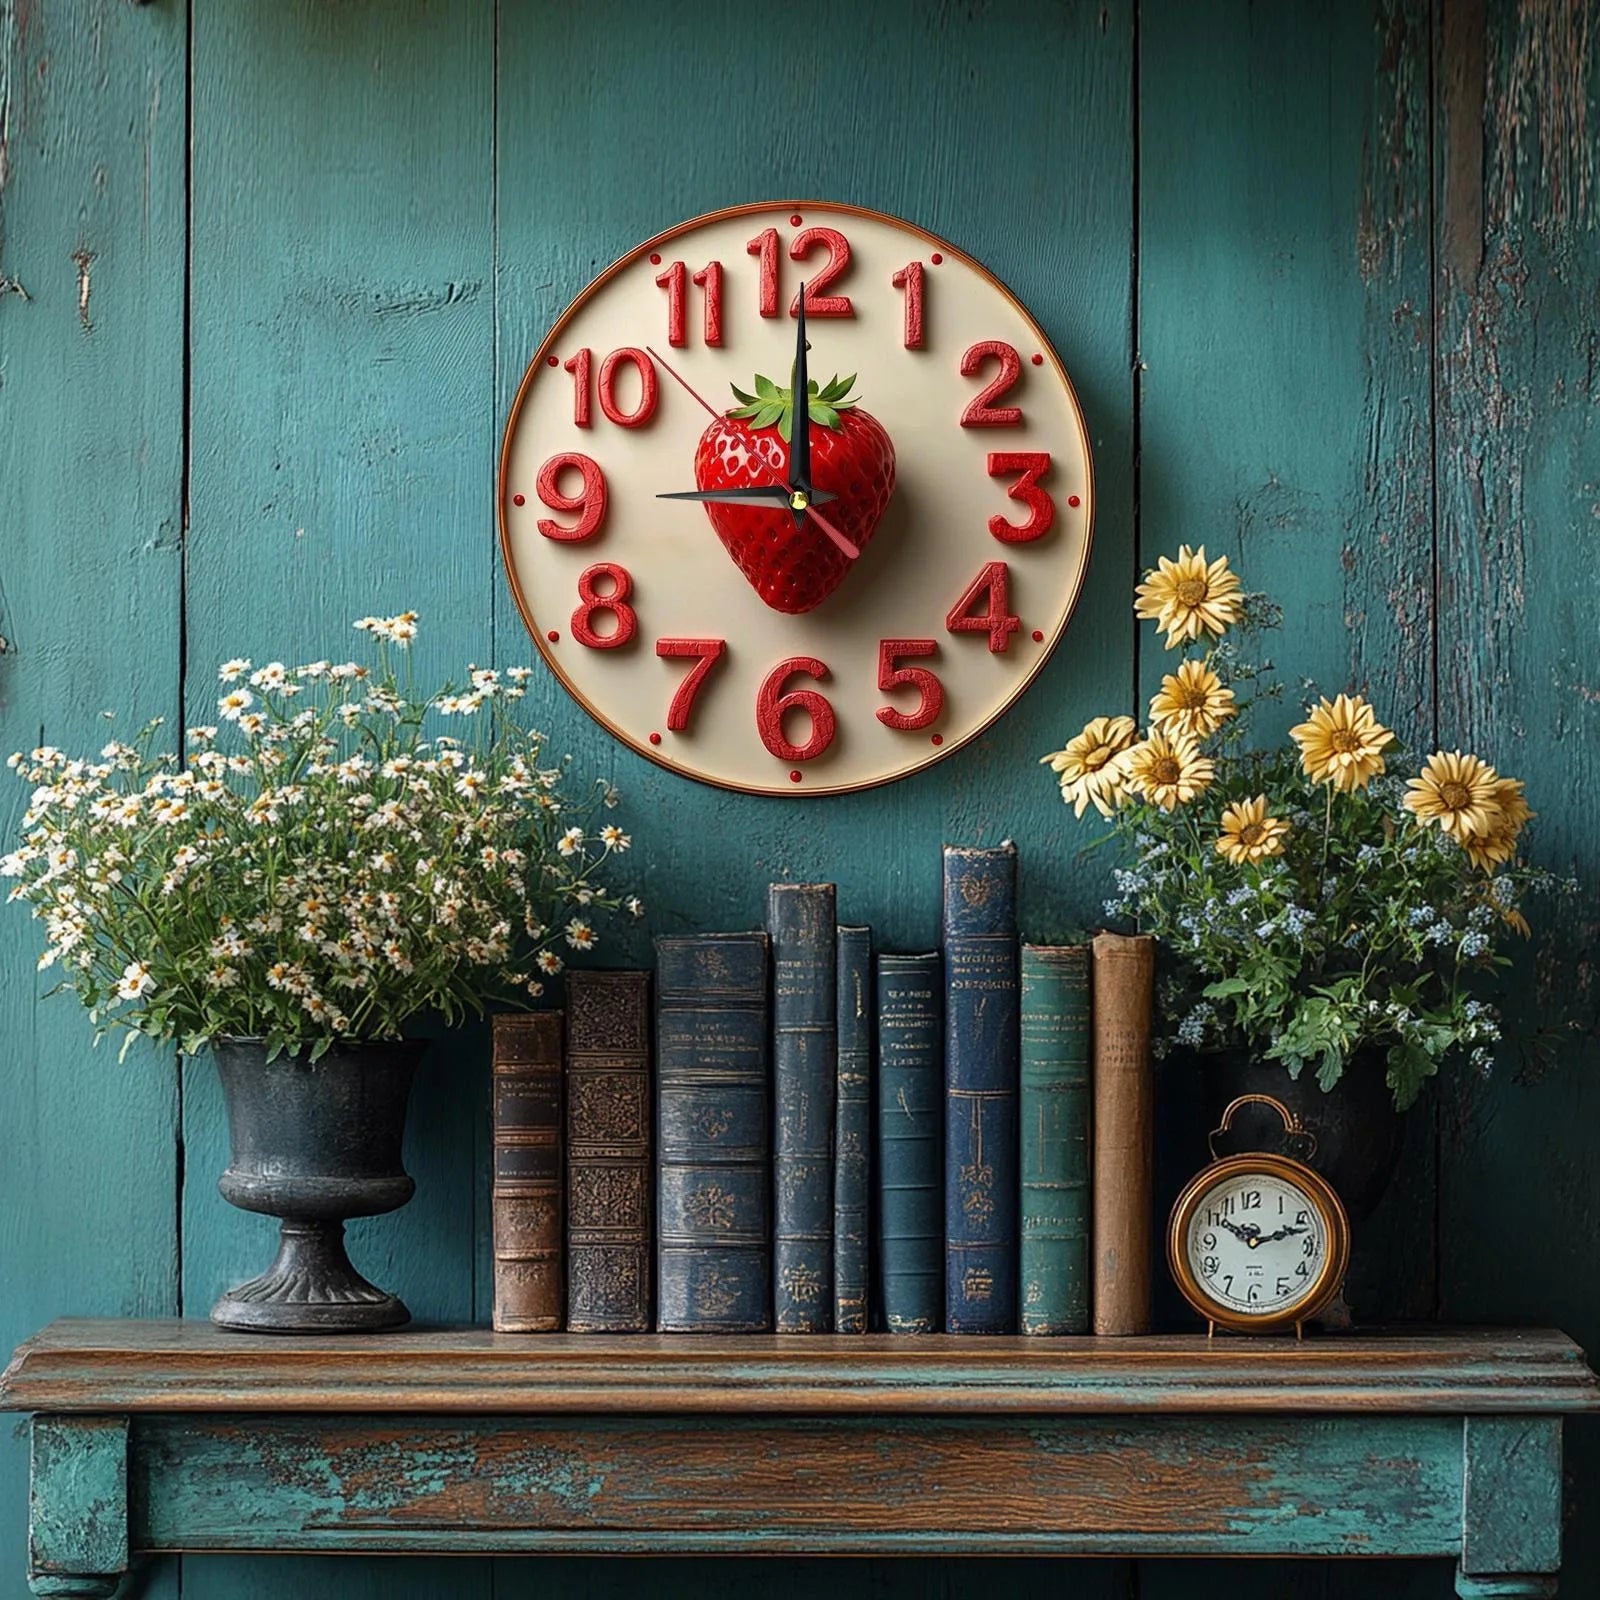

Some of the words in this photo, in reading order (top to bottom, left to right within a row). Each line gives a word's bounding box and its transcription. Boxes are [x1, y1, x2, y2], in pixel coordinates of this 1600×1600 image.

[655, 260, 726, 350] 11
[746, 226, 855, 319] 12
[891, 260, 925, 351] 1
[563, 346, 660, 430] 10
[959, 340, 1022, 428] 2
[535, 452, 609, 543] 9
[985, 451, 1056, 544] 3
[569, 561, 639, 650] 8
[945, 560, 1022, 654] 4
[655, 637, 727, 732] 7
[755, 655, 837, 763] 6
[875, 637, 946, 731] 5
[1202, 1232, 1217, 1251] 9
[1278, 1195, 1284, 1215] 1
[1223, 1275, 1234, 1296] 7
[1295, 1260, 1310, 1278] 4
